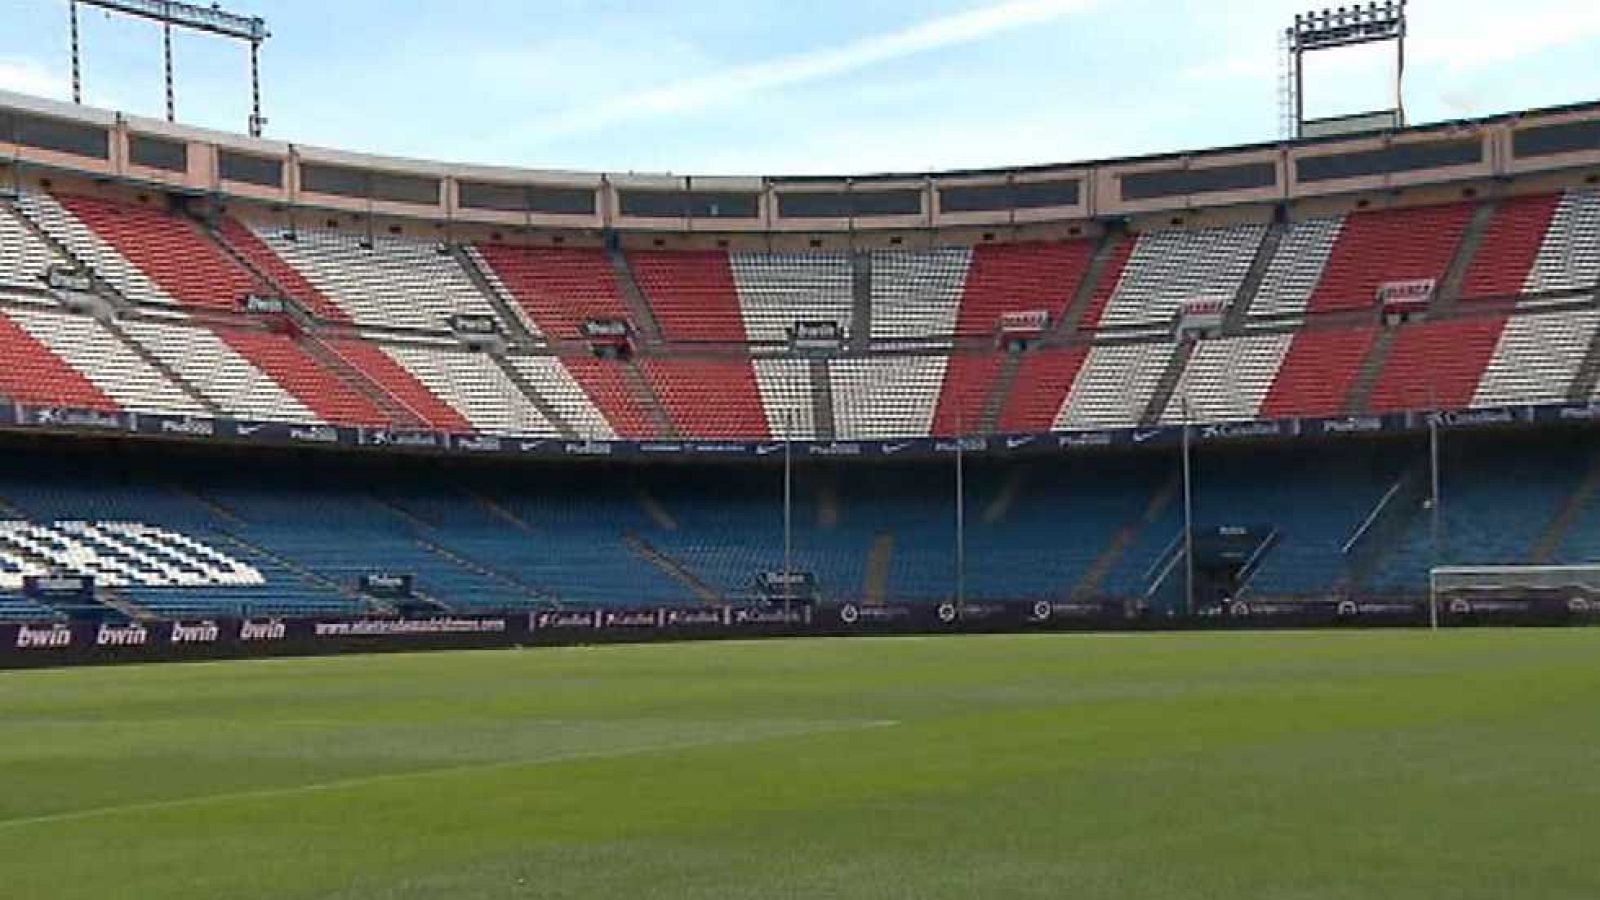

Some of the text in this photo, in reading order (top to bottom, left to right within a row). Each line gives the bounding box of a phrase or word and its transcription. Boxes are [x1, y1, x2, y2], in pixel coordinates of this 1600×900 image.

[16, 623, 71, 647] bwin
[97, 622, 148, 645] bwin
[171, 619, 219, 641] bwin
[239, 616, 286, 639] bwin
